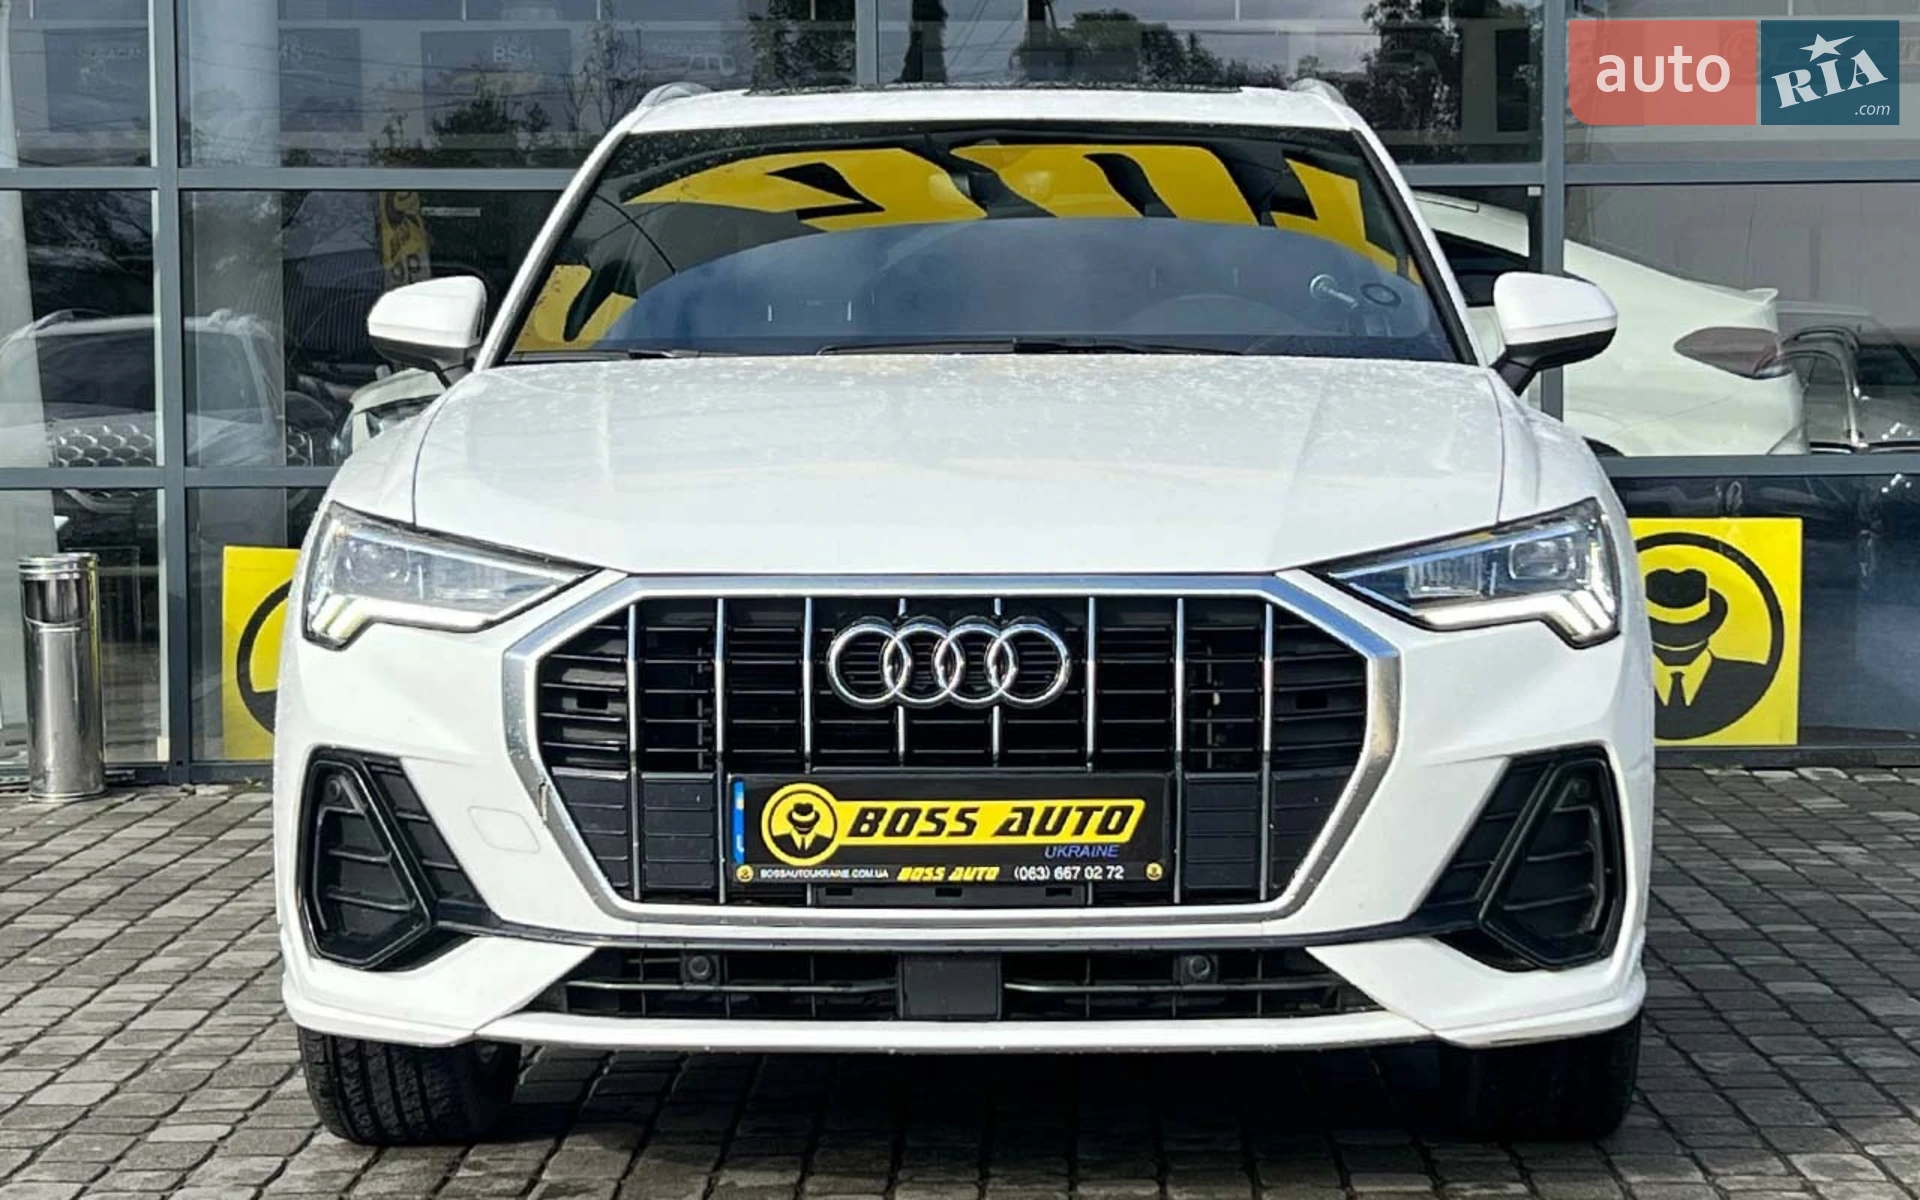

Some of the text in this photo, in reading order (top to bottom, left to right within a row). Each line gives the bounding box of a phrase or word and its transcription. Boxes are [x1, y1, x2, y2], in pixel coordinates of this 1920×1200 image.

[847, 805, 1135, 838] BOSS AUTO
[1044, 845, 1120, 859] UKRAINE
[897, 867, 946, 882] BOSS
[948, 866, 1000, 882] AUTO
[1013, 865, 1050, 881] (063)
[1053, 866, 1081, 880] 667
[1084, 866, 1103, 880] 02
[1106, 865, 1125, 880] 72
